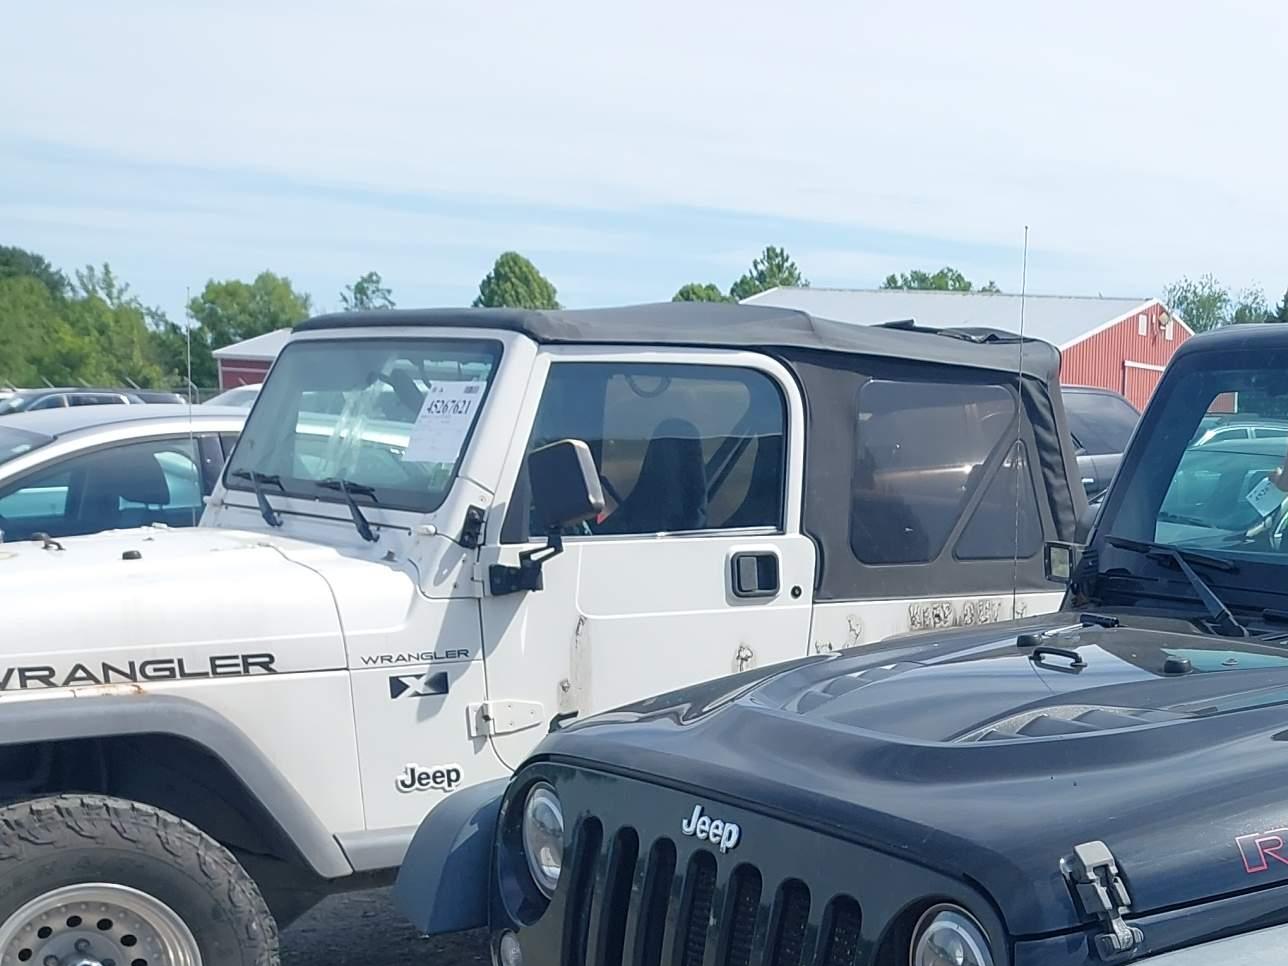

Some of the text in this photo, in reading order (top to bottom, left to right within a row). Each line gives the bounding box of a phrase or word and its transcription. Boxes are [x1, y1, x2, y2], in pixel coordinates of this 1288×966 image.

[427, 400, 472, 415] 45267621
[361, 649, 470, 665] WRANGLER
[398, 765, 463, 791] Jeep
[682, 804, 740, 854] Jeep
